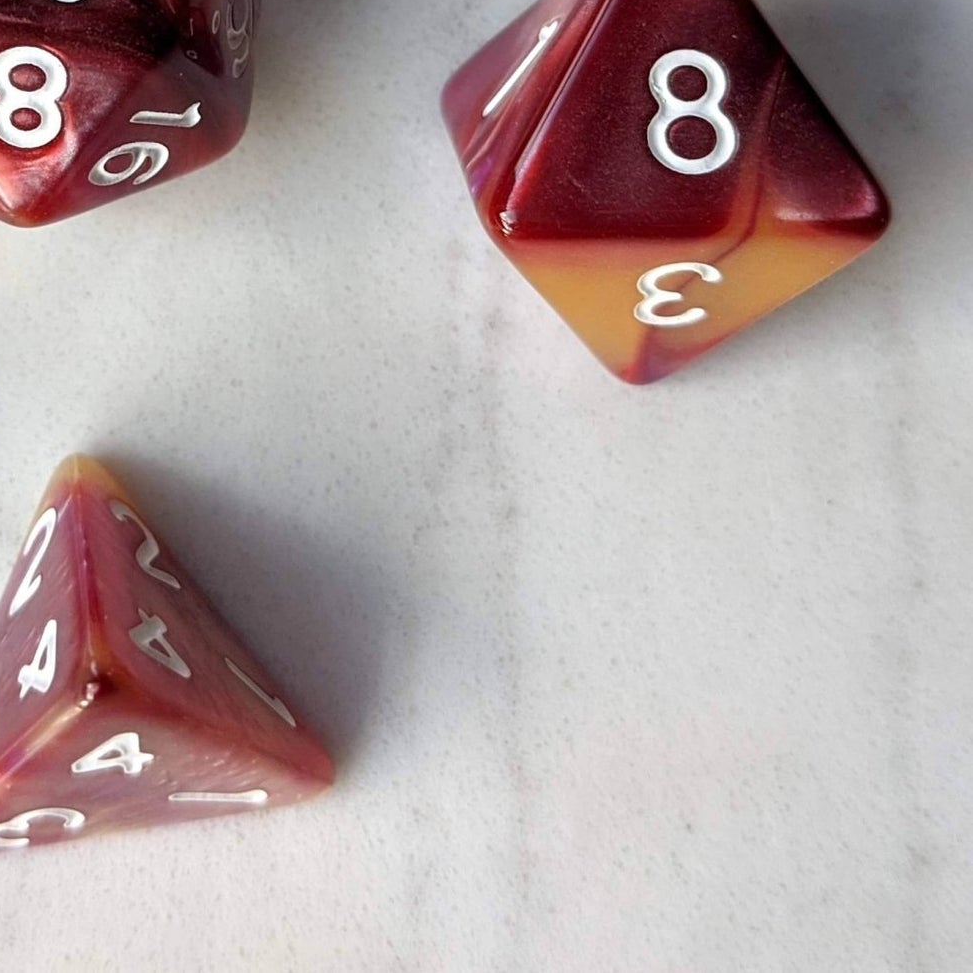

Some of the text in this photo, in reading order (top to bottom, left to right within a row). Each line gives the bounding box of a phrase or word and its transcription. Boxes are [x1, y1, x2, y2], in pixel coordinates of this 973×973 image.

[482, 19, 559, 117] 1
[88, 101, 201, 186] 16
[647, 49, 737, 175] 8
[633, 262, 723, 327] 3
[9, 507, 57, 617] 2
[110, 499, 181, 589] 2
[18, 619, 57, 700] 4
[129, 608, 191, 678] 4
[71, 732, 154, 774] 4
